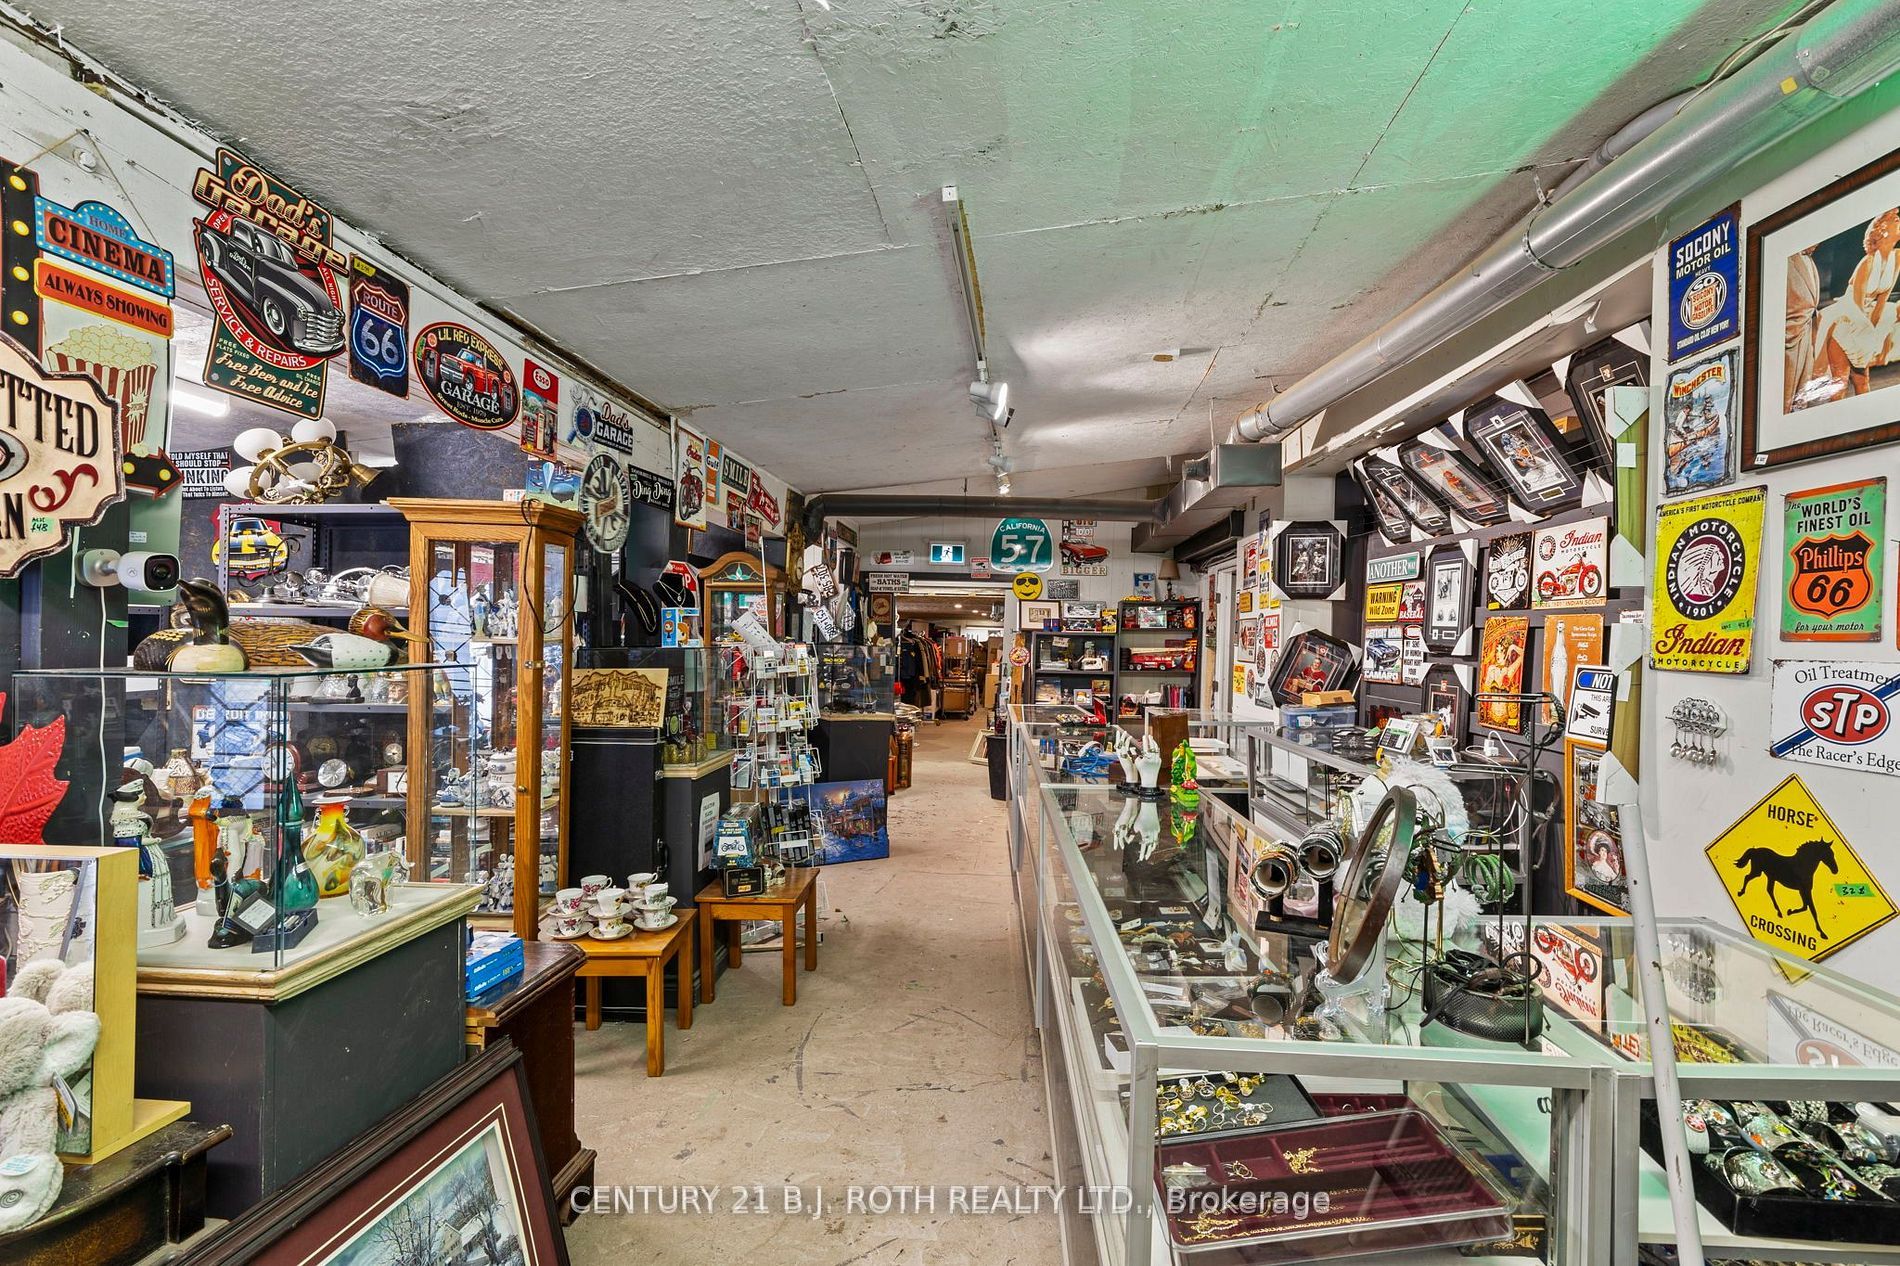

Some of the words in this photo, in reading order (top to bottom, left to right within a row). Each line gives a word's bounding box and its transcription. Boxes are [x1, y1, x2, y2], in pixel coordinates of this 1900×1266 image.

[230, 166, 322, 239] Dad's
[89, 213, 128, 240] HOME
[213, 213, 229, 230] OPEN
[49, 214, 164, 284] CINEMA
[1676, 221, 1731, 269] SOCONY
[322, 267, 331, 281] ALL
[1675, 252, 1711, 280] MOTOR
[1713, 242, 1732, 259] OIL
[45, 273, 103, 307] ALWAYS
[106, 295, 168, 328] SHOWING
[363, 292, 398, 319] ROUTE
[1692, 286, 1714, 303] SOCONY
[1693, 298, 1713, 313] MOTOR
[208, 277, 246, 339] SERVICE
[245, 337, 254, 349] &
[257, 346, 307, 368] REPAIRS
[361, 318, 399, 365] 66
[453, 328, 470, 345] RED
[470, 335, 504, 371] EXPRESS
[216, 353, 248, 373] Free
[249, 363, 277, 384] Beer
[280, 378, 301, 393] and
[302, 382, 318, 399] Ice
[1673, 365, 1723, 397] WINCHESTER
[230, 374, 262, 395] Free
[263, 386, 303, 408] Advice
[441, 380, 500, 415] GARAGE
[601, 402, 630, 431] Dad's
[596, 422, 634, 448] GARAGE
[170, 452, 183, 460] OLD
[185, 451, 211, 460] MYSELF
[213, 451, 228, 460] THAT
[175, 460, 202, 468] SHOULD
[204, 459, 220, 467] STOP
[183, 468, 229, 484] INKIN
[723, 457, 749, 487] SMILE
[632, 480, 651, 503] Ding
[653, 481, 671, 504] Dong
[1658, 506, 1684, 518] AMERICA'S
[1684, 503, 1700, 515] FIRST
[1701, 498, 1737, 511] MOTORCYCLE
[1738, 494, 1765, 505] COMPANY
[1785, 500, 1802, 513] The
[1801, 496, 1862, 518] WORLD'S
[1000, 522, 1046, 534] CALIFORNIA
[1797, 517, 1843, 534] FINEST
[1849, 511, 1871, 527] OIL
[1001, 534, 1045, 563] 57
[1560, 529, 1603, 549] Indian
[1561, 544, 1602, 554] MOTORCYCLE
[1062, 566, 1106, 575] BIGGER
[1368, 560, 1408, 579] ANOTHER
[1667, 538, 1685, 601] INDIAN
[1689, 521, 1743, 597] MOTORCYCLE
[1799, 544, 1864, 573] Phillips
[1370, 591, 1397, 605] WARNING
[1807, 574, 1855, 608] 66
[1369, 606, 1380, 616] Wild
[1381, 606, 1395, 616] Zone
[1686, 604, 1713, 618] 1901
[1655, 623, 1745, 657] Indian
[1795, 621, 1809, 634] for
[1810, 623, 1835, 634] your
[1836, 622, 1865, 632] motor
[1658, 657, 1740, 669] MOTORCYCLE
[1795, 667, 1819, 684] Oil
[1810, 692, 1882, 735] STP
[1791, 742, 1814, 758] The
[1816, 745, 1863, 766] Racer's
[1865, 751, 1900, 774] Edge
[1768, 804, 1814, 829] HORSE
[1750, 915, 1817, 951] CROSSING
